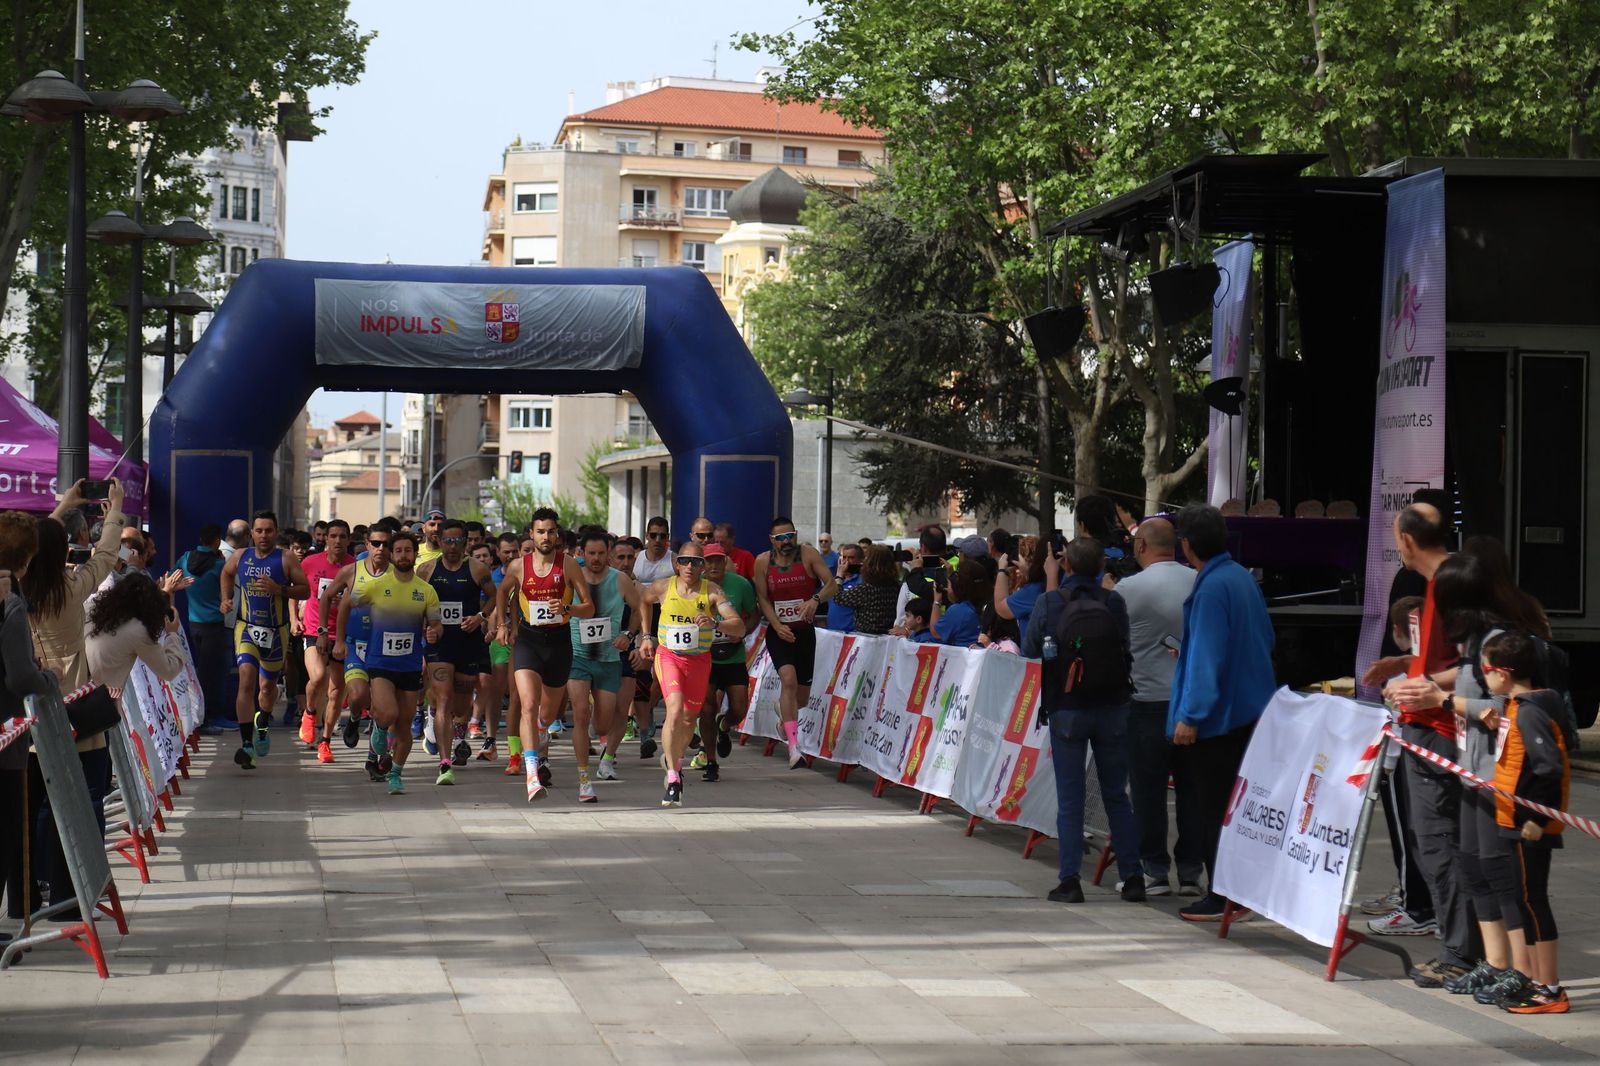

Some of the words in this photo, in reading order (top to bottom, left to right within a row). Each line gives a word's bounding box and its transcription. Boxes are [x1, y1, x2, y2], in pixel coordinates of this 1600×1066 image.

[361, 299, 399, 312] NOS
[527, 327, 576, 342] Junta
[580, 328, 603, 341] de
[473, 346, 537, 359] Castilla
[244, 566, 272, 577] JESUS
[537, 608, 555, 620] 25
[253, 630, 268, 642] 92
[587, 624, 605, 637] 37
[387, 638, 411, 650] 156
[674, 632, 692, 644] 18
[1242, 798, 1286, 831] VALORES
[1287, 836, 1312, 865] Castilla
[1309, 851, 1321, 874] y
